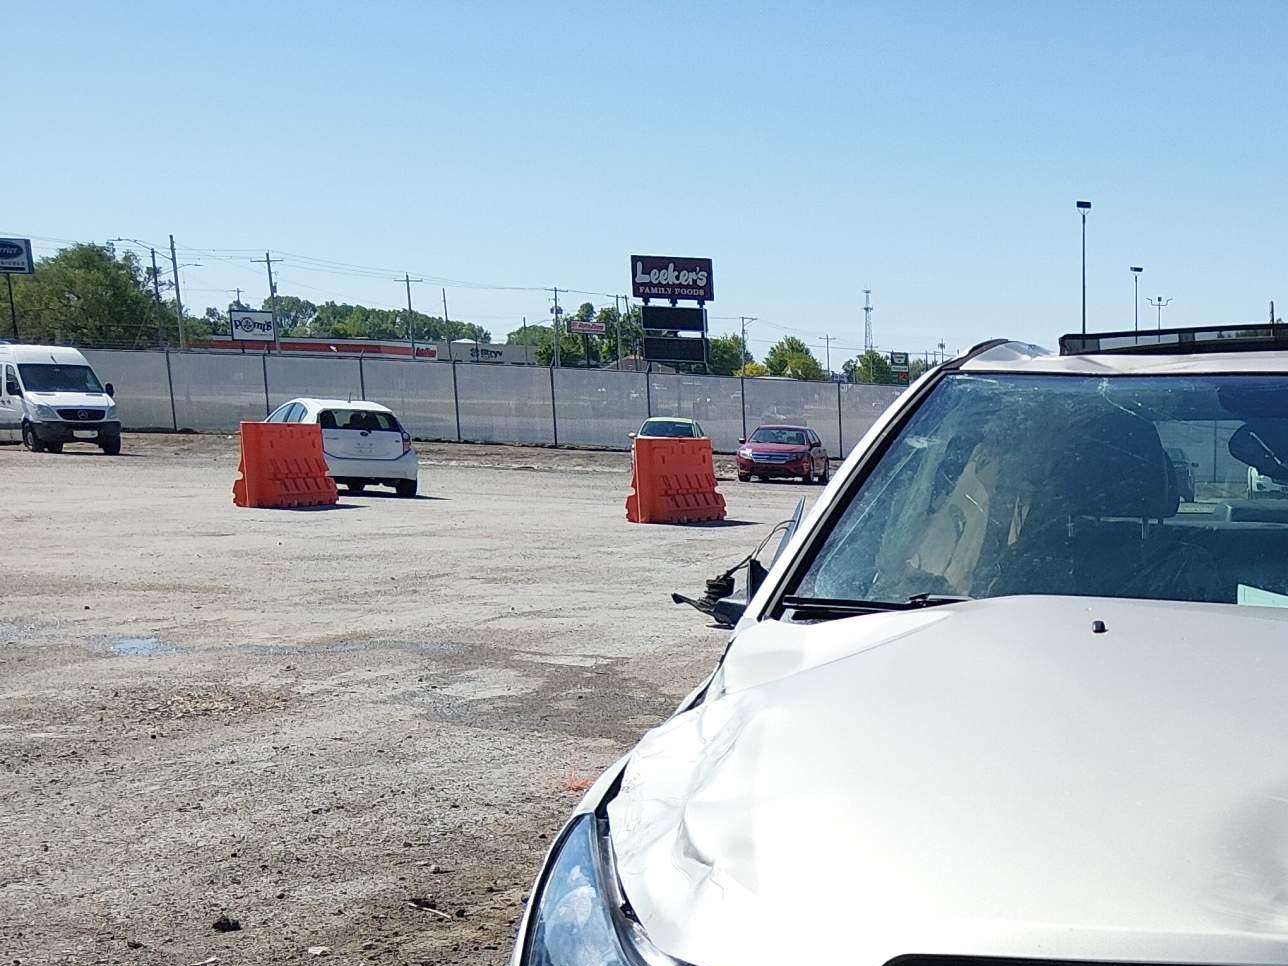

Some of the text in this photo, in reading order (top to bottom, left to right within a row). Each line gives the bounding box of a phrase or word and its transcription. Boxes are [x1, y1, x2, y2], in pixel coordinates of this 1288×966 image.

[635, 261, 708, 286] Leeker's
[639, 286, 705, 296] FAMILY FOODS
